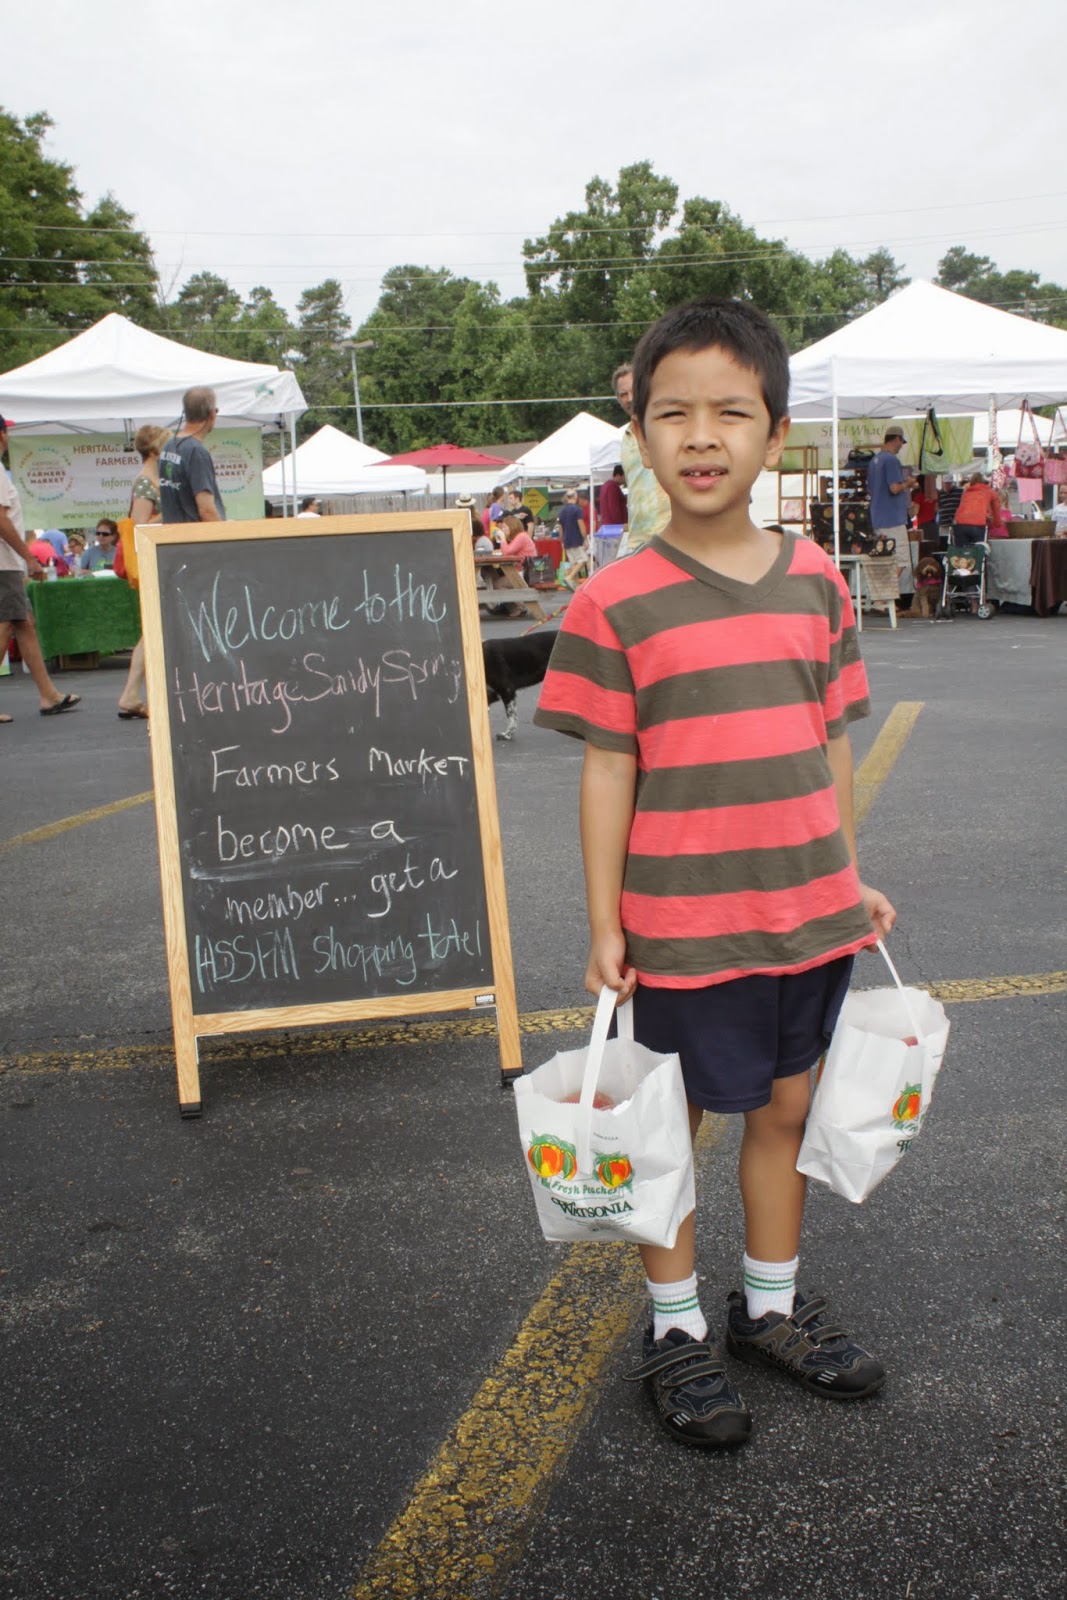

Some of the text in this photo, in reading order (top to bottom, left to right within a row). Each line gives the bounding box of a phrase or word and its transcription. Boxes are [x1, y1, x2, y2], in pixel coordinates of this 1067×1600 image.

[96, 456, 139, 466] FARMERS
[177, 564, 446, 662] Welcome to the
[174, 659, 303, 734] Heritage
[303, 652, 381, 718] Sandy
[211, 744, 340, 793] Farmers
[217, 815, 406, 862] become a
[367, 853, 424, 918] get
[429, 856, 459, 881] a
[551, 1181, 618, 1196] Fresh Peaches
[551, 1197, 634, 1218] WATSONIA
